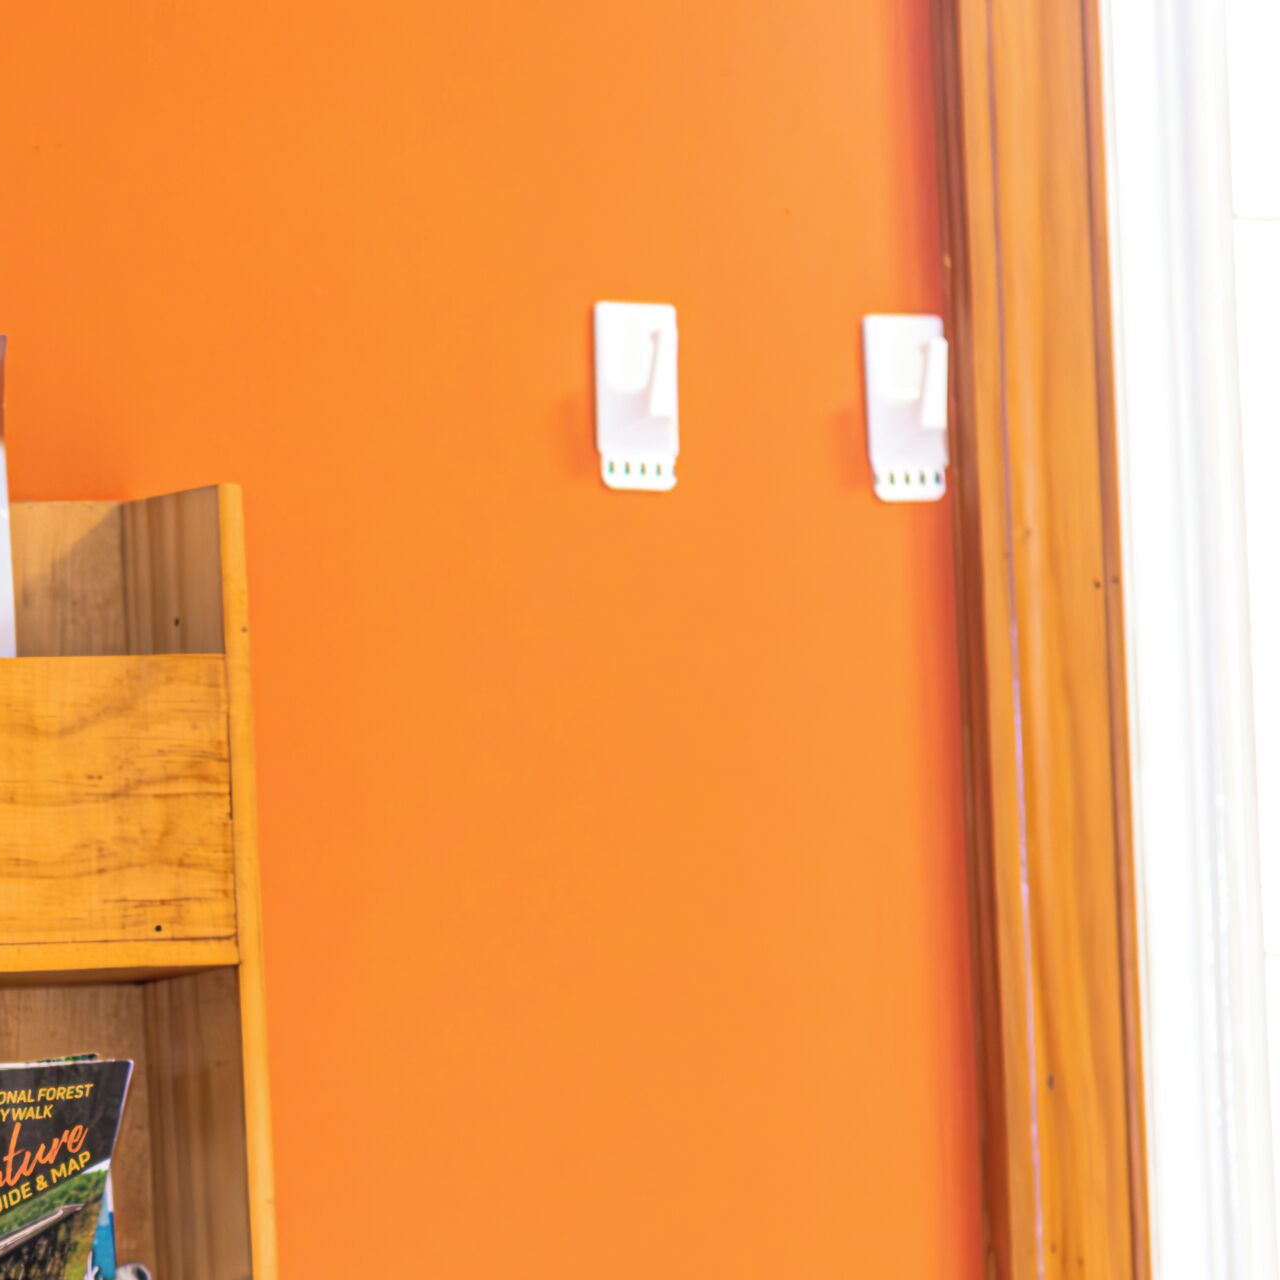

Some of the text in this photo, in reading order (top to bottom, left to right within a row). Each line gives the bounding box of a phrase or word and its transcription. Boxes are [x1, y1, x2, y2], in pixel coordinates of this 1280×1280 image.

[37, 1084, 94, 1101] FOREST
[36, 1175, 48, 1191] &
[50, 1151, 91, 1183] MAP
